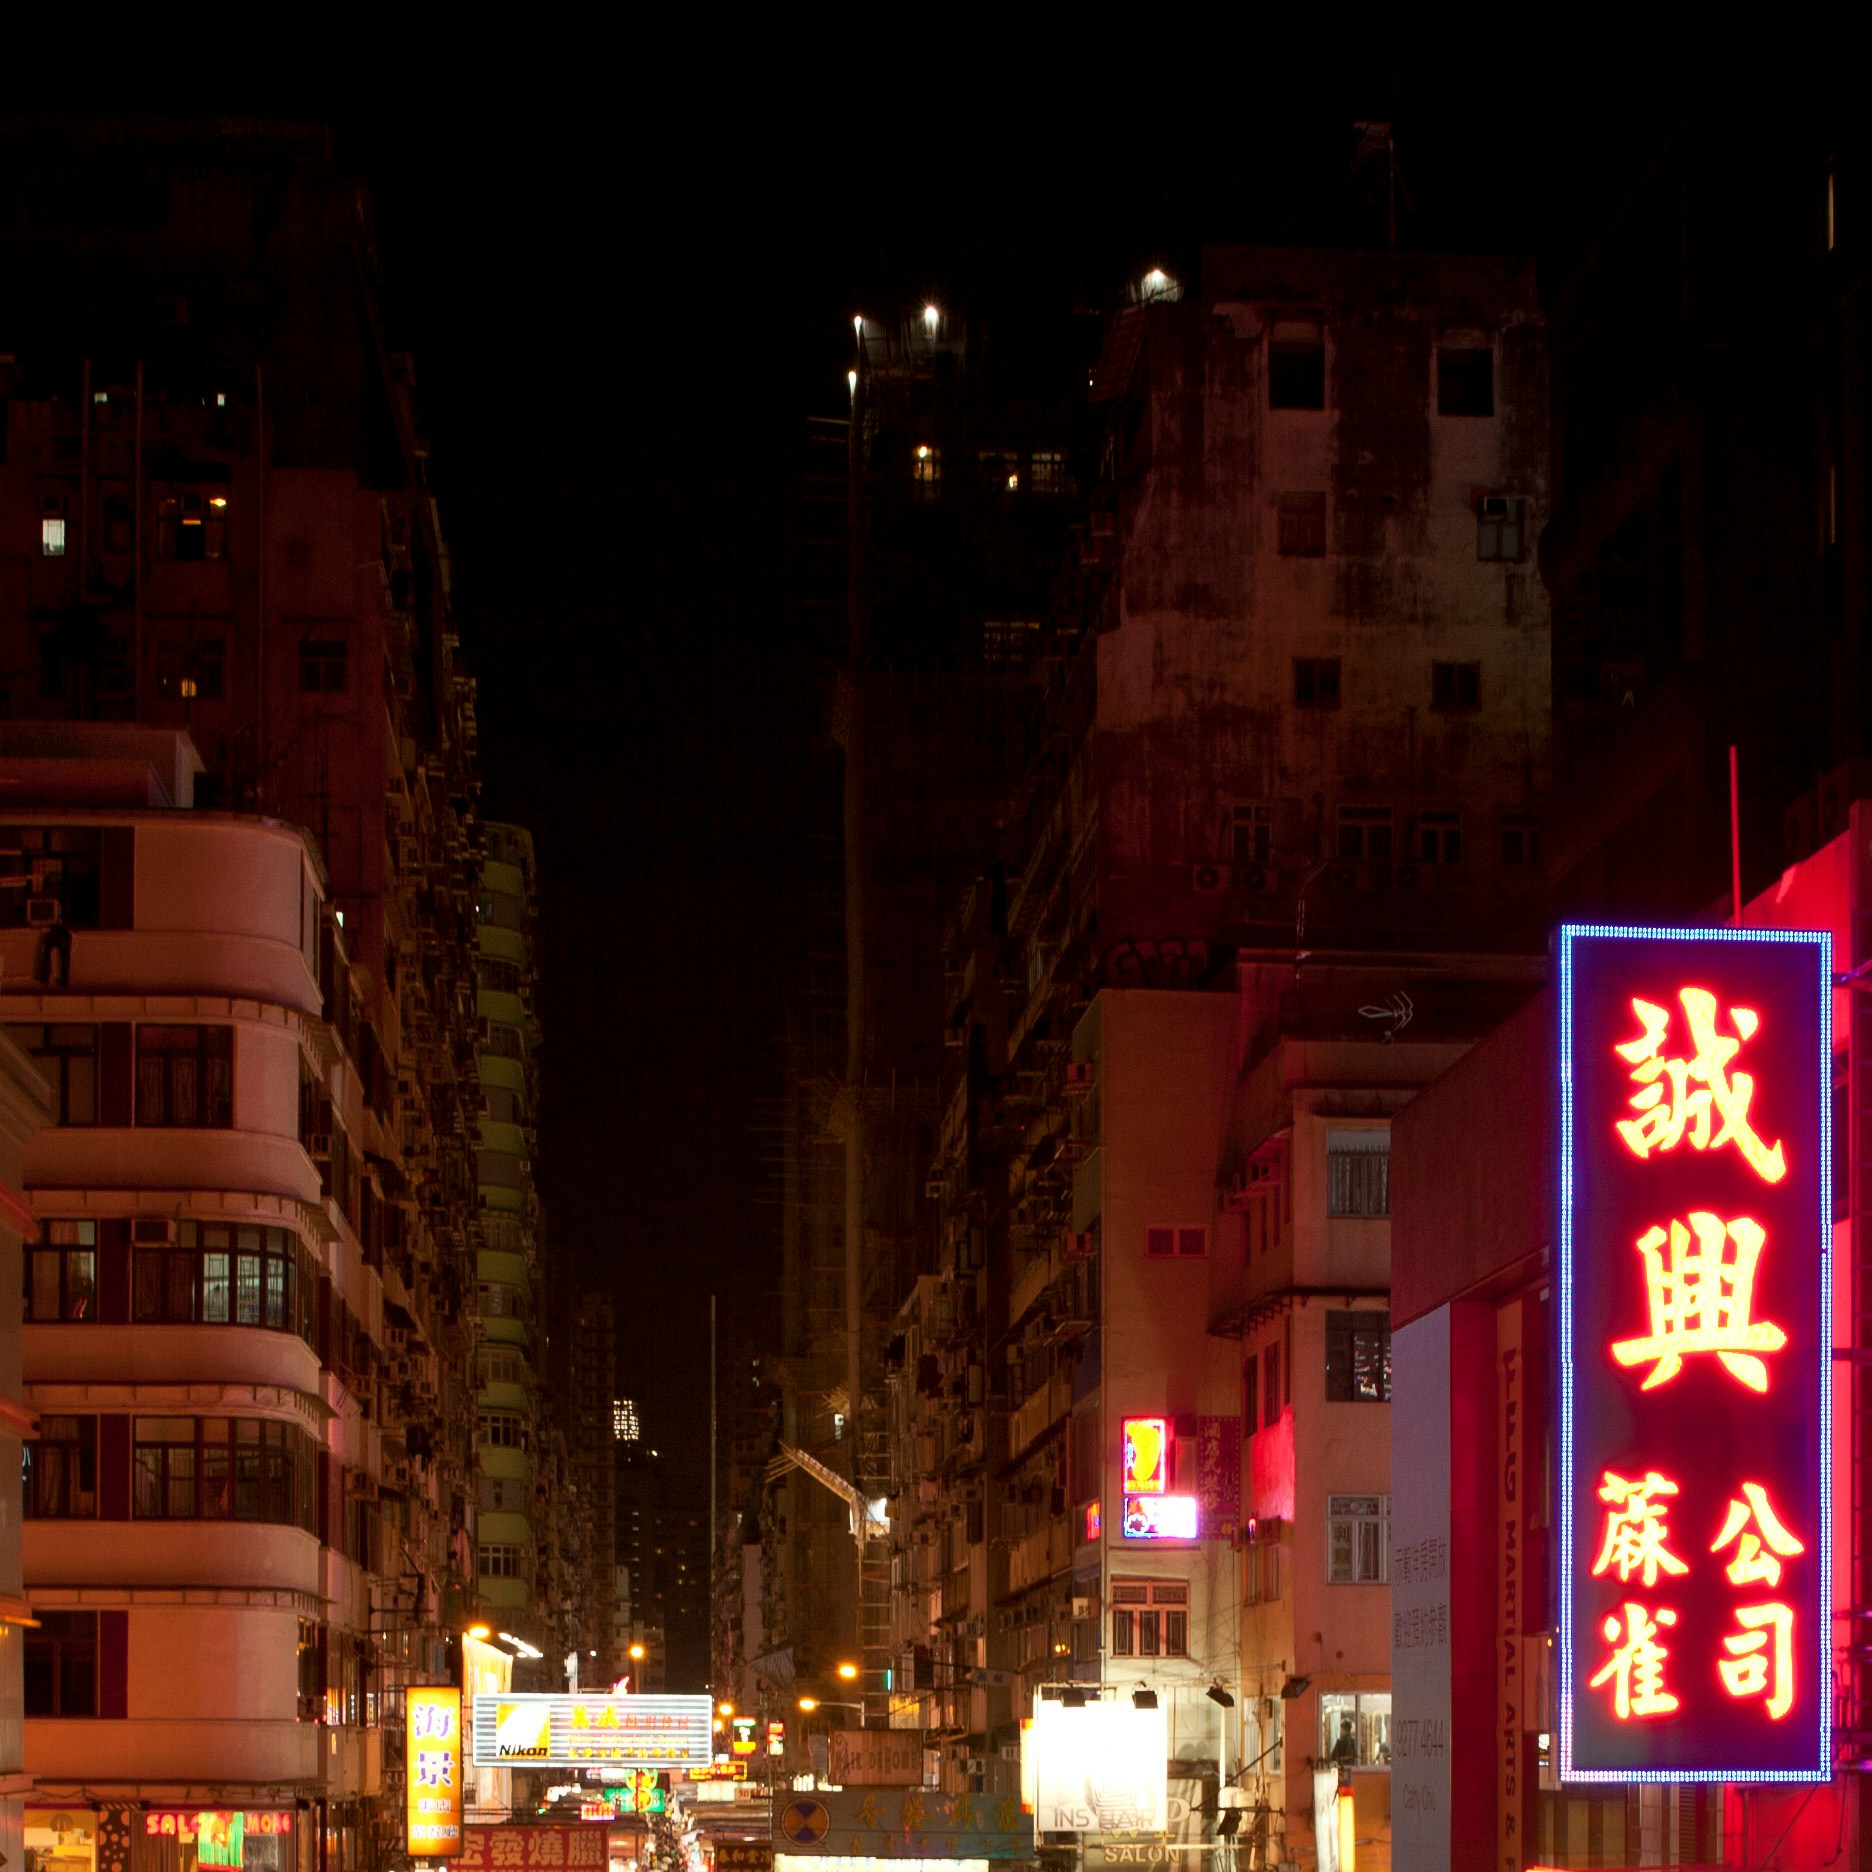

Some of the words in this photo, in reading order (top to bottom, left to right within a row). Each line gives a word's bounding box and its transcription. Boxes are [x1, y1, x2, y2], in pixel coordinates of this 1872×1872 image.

[1611, 986, 1786, 1393] 誠興
[1504, 1520, 1518, 1686] MARTIAL
[1711, 1481, 1806, 1720] 公司
[499, 1744, 548, 1757] Nikon
[1504, 1702, 1517, 1797] ARTS
[1504, 1812, 1517, 1839] &
